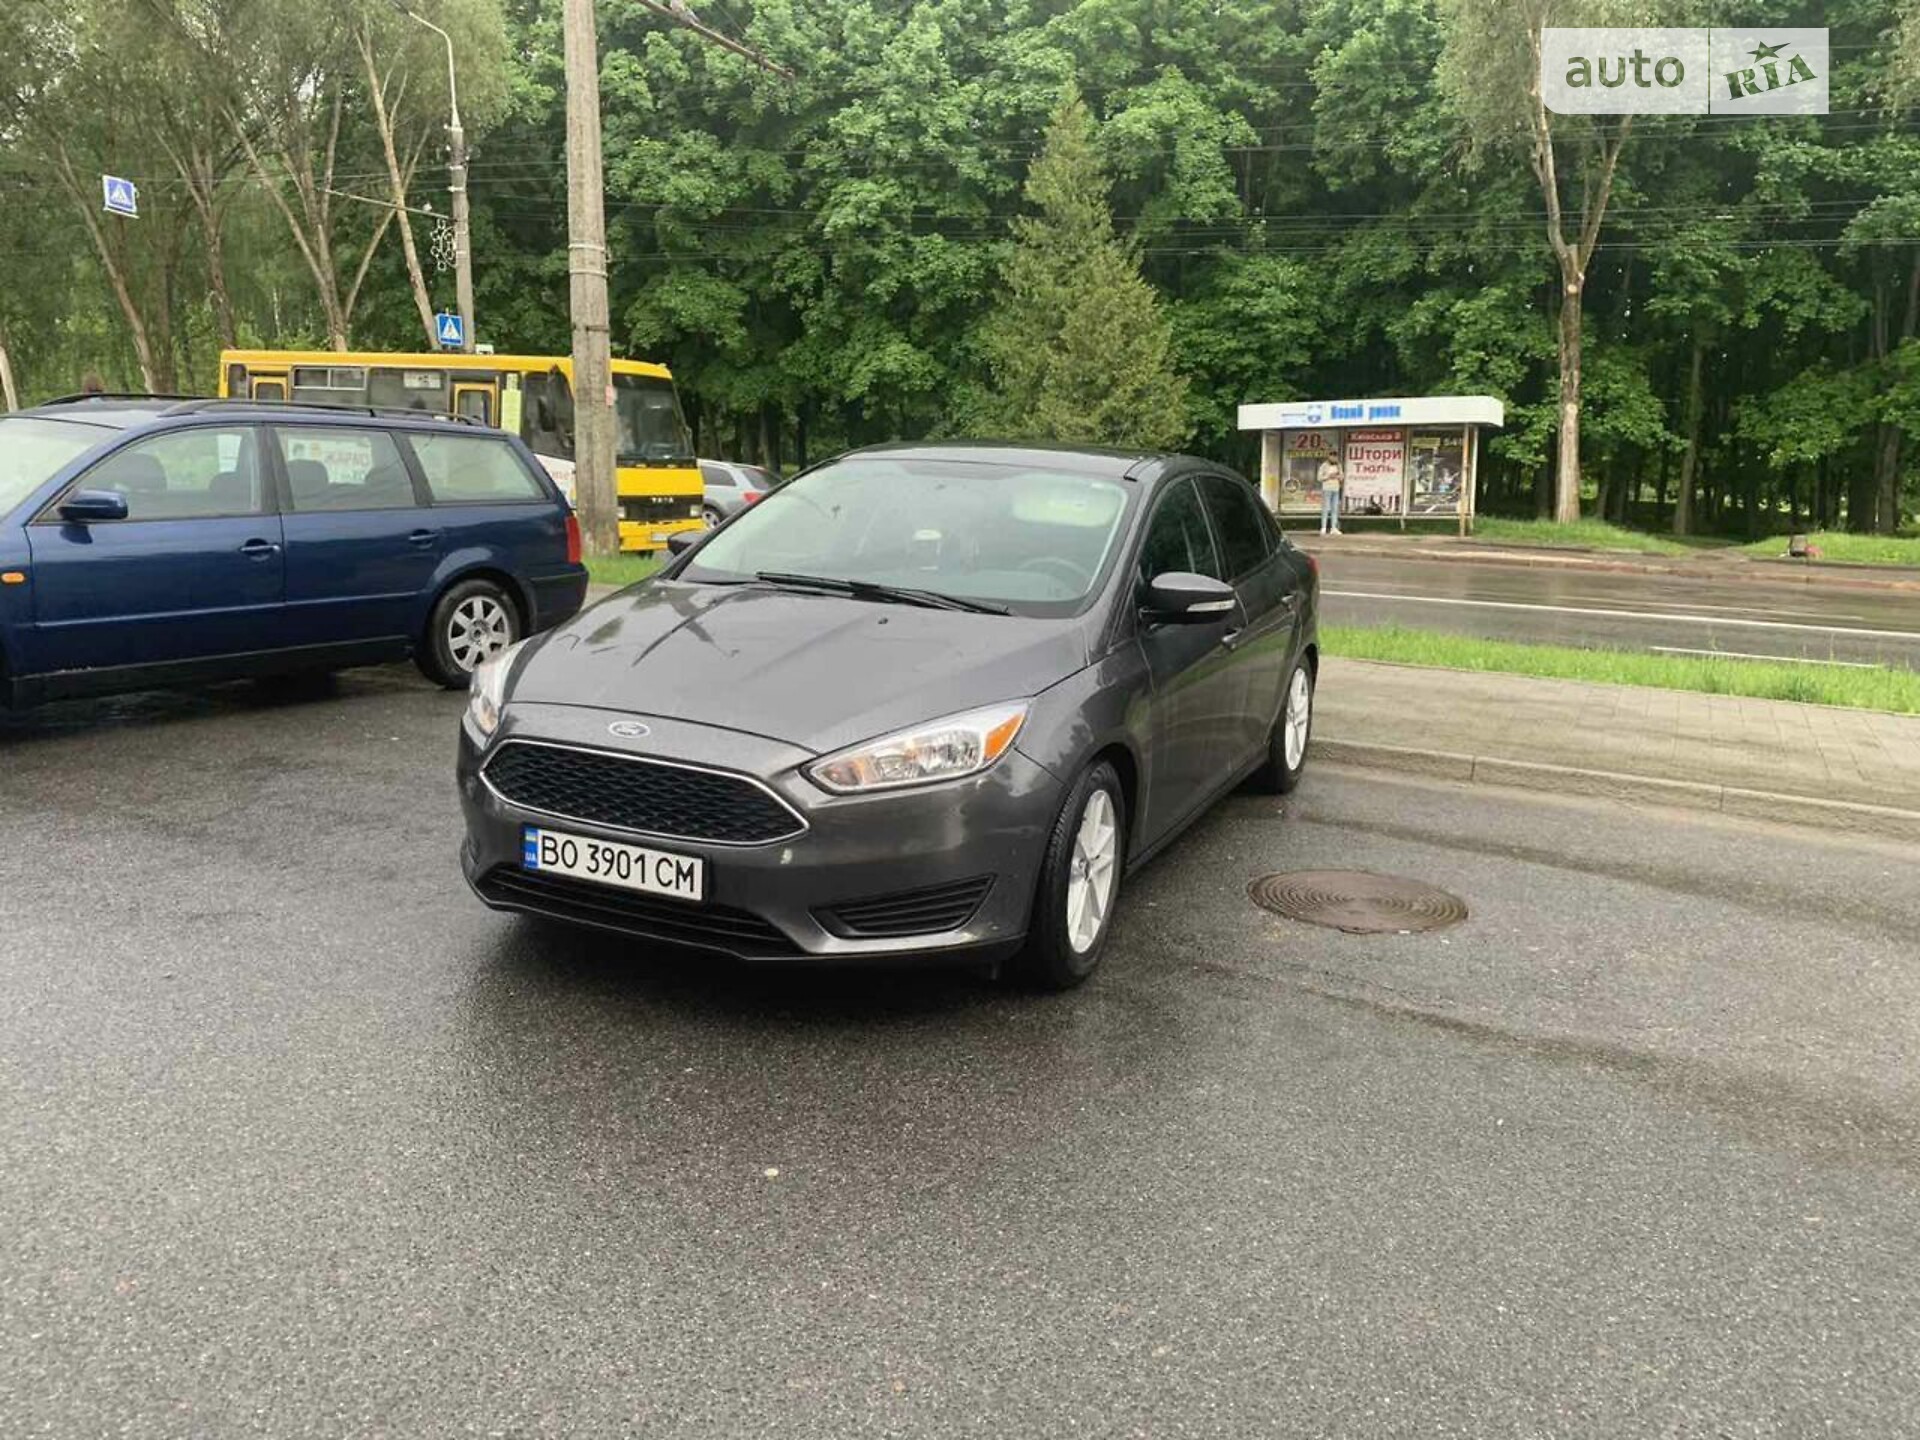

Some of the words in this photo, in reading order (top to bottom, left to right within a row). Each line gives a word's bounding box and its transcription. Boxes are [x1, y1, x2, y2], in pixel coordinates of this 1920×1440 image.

[1349, 447, 1402, 463] Штори
[541, 835, 578, 869] BO
[586, 844, 646, 884] 3901
[655, 857, 694, 893] CM
